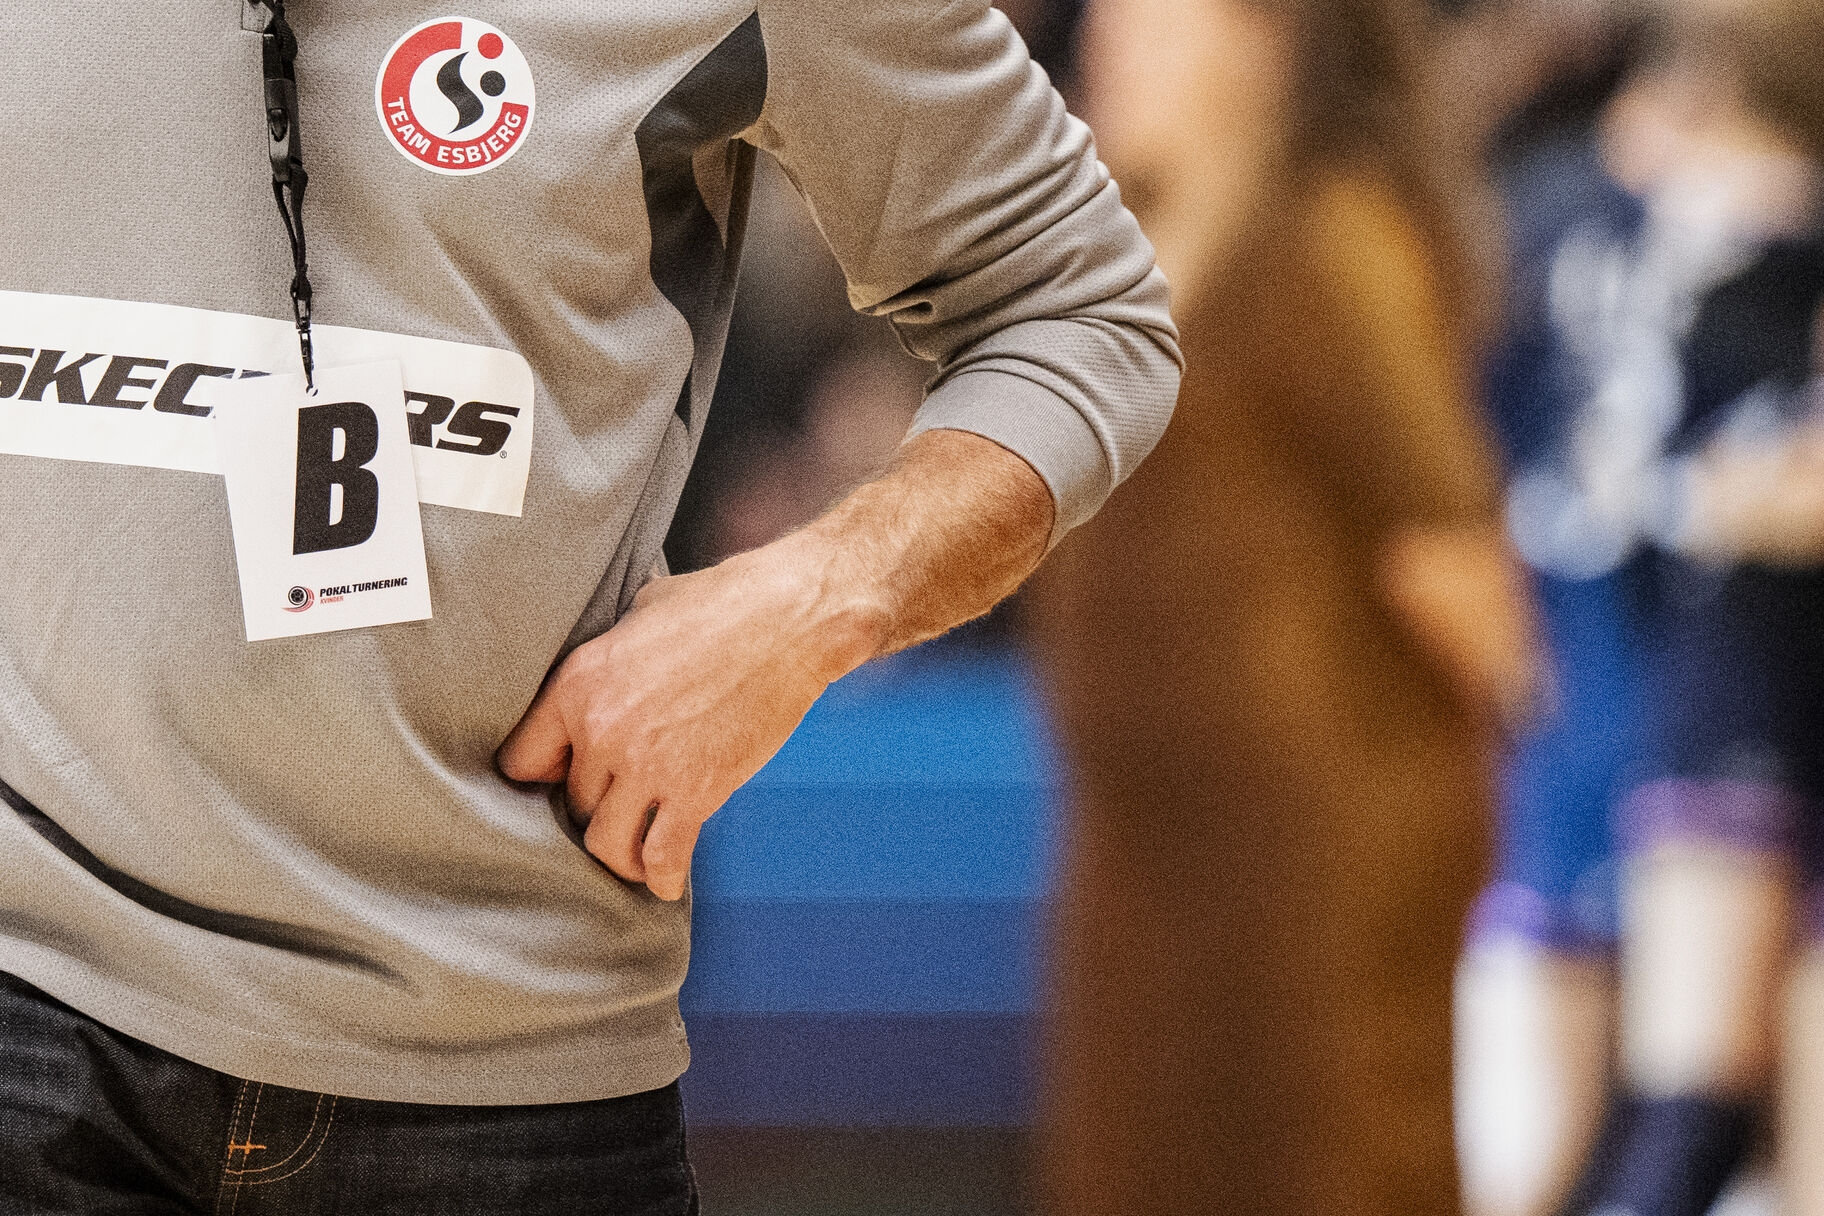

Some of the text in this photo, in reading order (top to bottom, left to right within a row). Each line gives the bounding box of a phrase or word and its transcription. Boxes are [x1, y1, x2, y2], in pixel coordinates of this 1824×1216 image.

[387, 96, 522, 164] TEAM ESBJERG
[292, 401, 380, 556] B
[319, 577, 408, 598] POKALTURNERING
